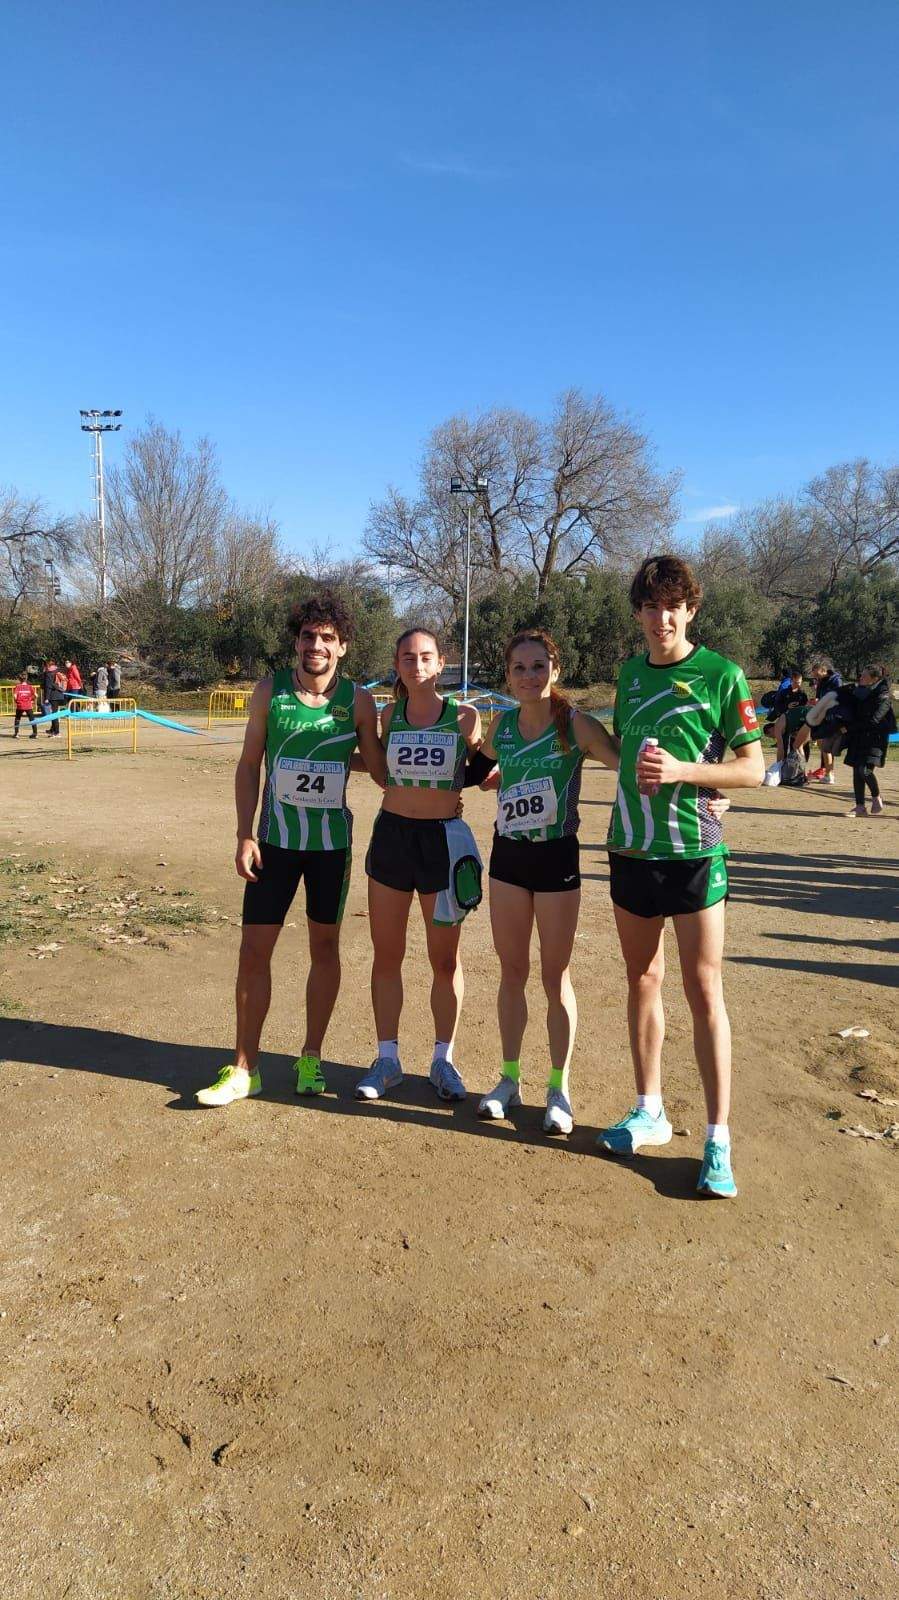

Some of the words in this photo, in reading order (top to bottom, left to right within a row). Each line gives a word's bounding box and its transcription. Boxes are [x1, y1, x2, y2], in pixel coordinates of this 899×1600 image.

[276, 716, 340, 735] Huesca
[397, 746, 446, 766] 229
[499, 753, 563, 769] Huesca
[295, 773, 325, 793] 24
[502, 795, 544, 821] 208
